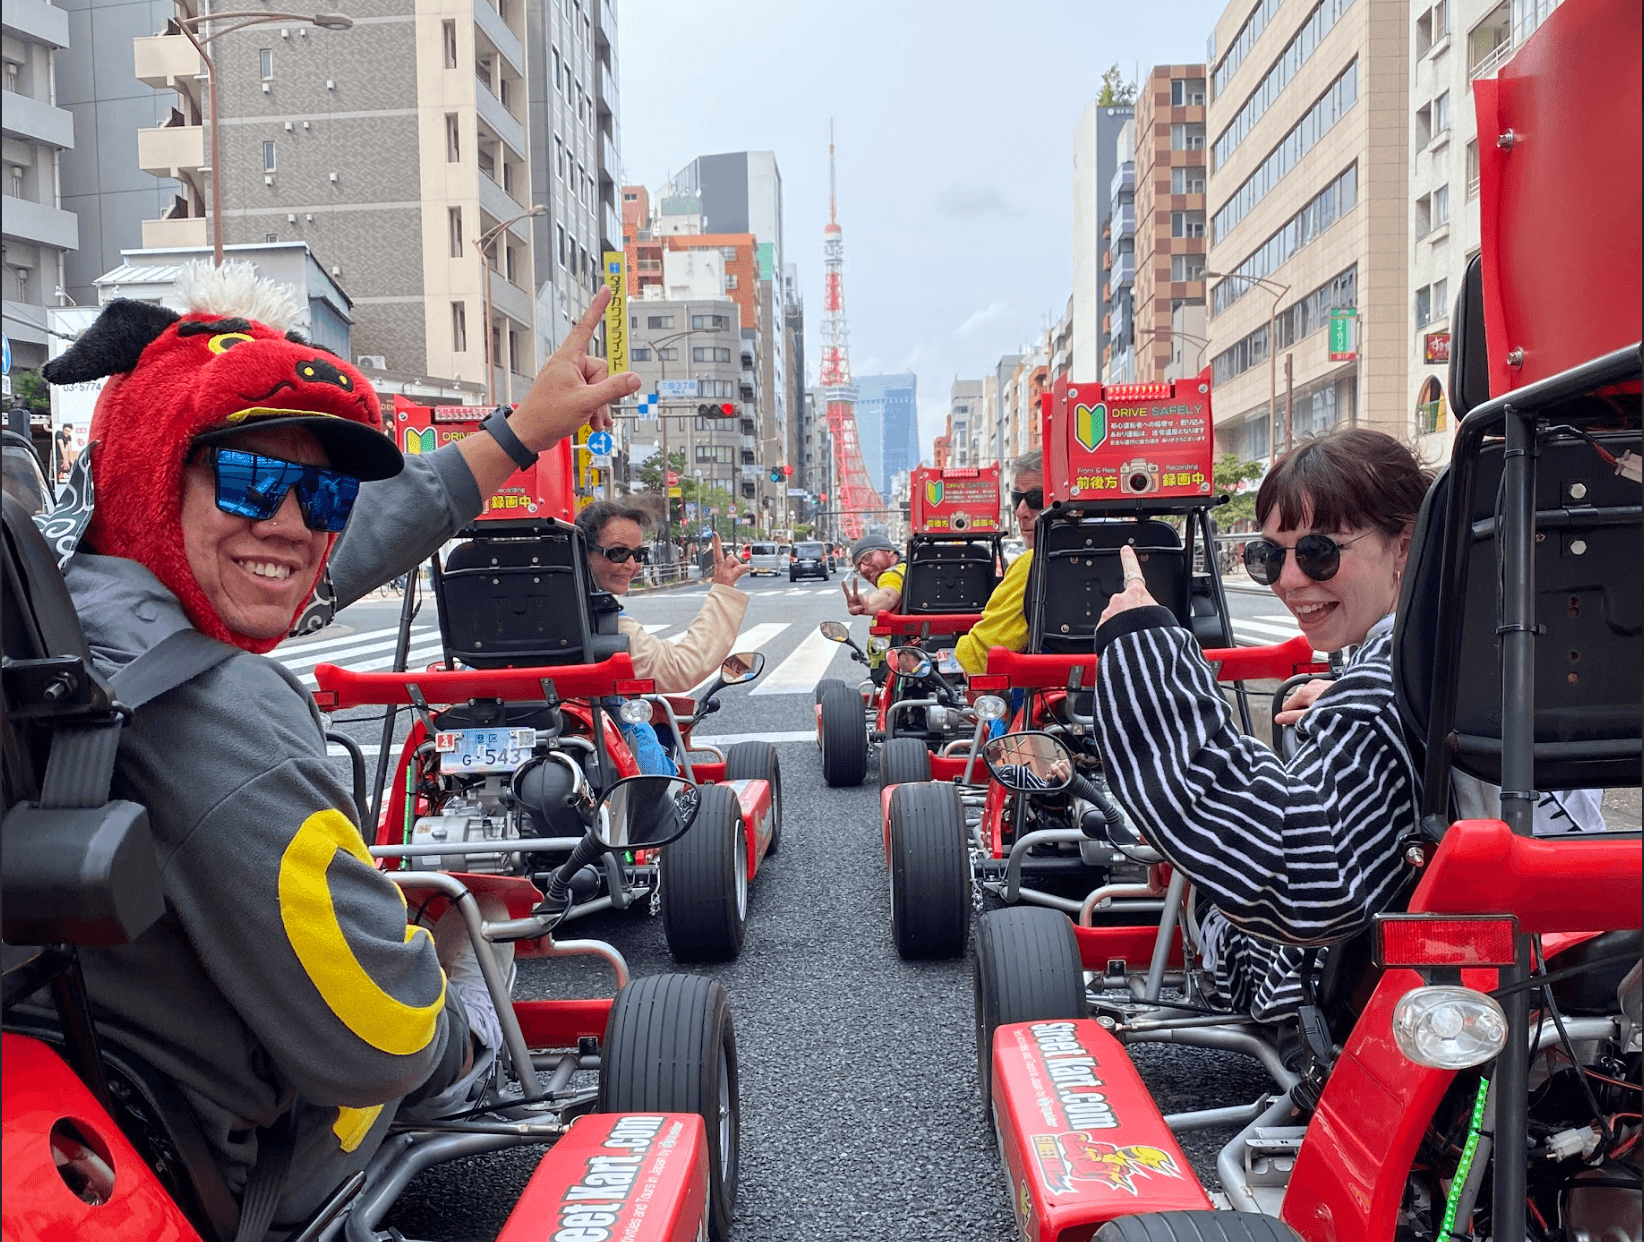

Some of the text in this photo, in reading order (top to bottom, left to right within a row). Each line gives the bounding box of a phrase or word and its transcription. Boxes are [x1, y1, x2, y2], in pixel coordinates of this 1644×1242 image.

[1111, 404, 1202, 418] DRIVE SAFELY
[1165, 463, 1199, 471] Recording
[1076, 475, 1119, 490] 前後方
[1162, 471, 1205, 487] 録画中
[491, 495, 531, 509] 録画中
[1030, 1022, 1089, 1058] Street
[648, 1156, 666, 1176] Japan
[635, 1183, 657, 1204] Tours
[633, 1203, 648, 1217] and
